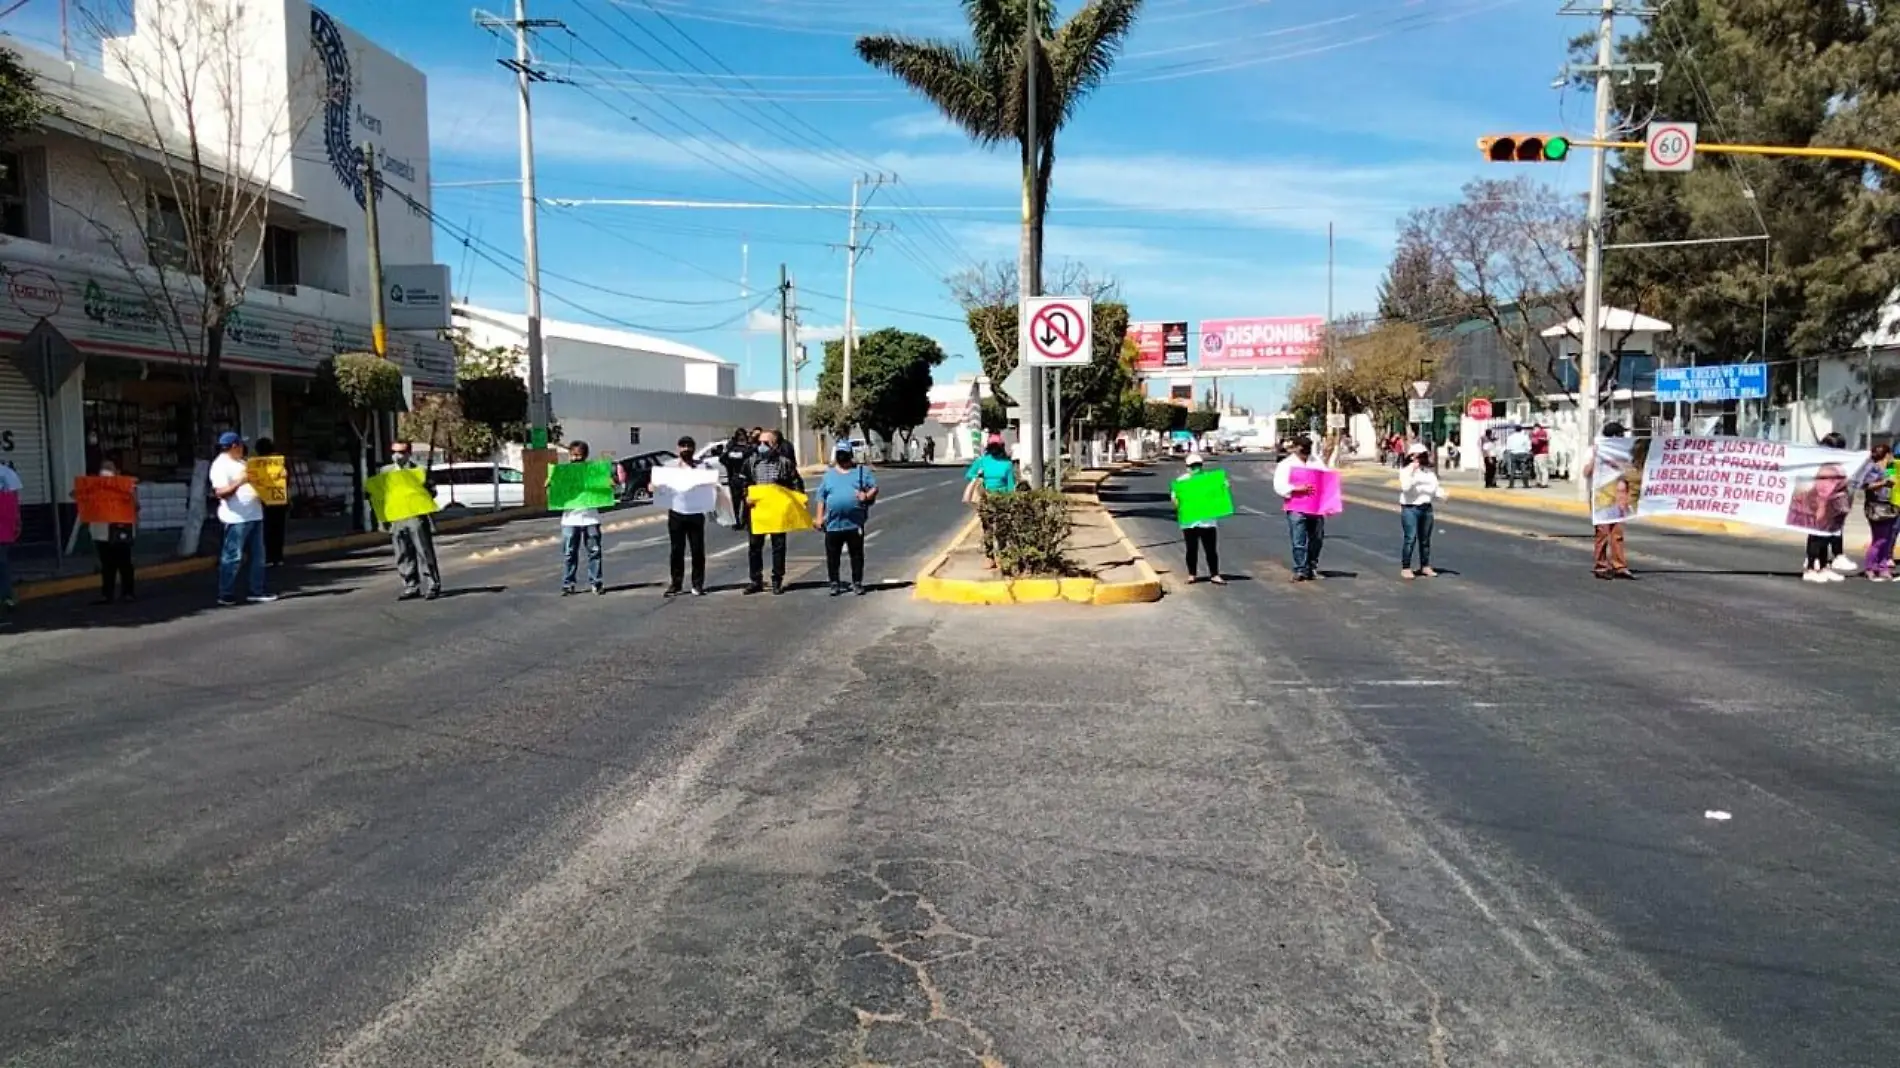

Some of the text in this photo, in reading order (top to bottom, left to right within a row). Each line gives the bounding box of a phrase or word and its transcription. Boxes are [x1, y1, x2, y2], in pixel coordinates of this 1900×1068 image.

[1659, 136, 1682, 153] 60
[1225, 323, 1321, 344] DISPONIBLE
[1664, 438, 1785, 458] SE PIDE JUSTICIA
[1660, 453, 1695, 466] PARA
[1700, 454, 1716, 467] LA
[1734, 473, 1754, 485] DE
[1758, 474, 1788, 489] LOS
[1644, 483, 1786, 505] HERMANOS ROMERO
